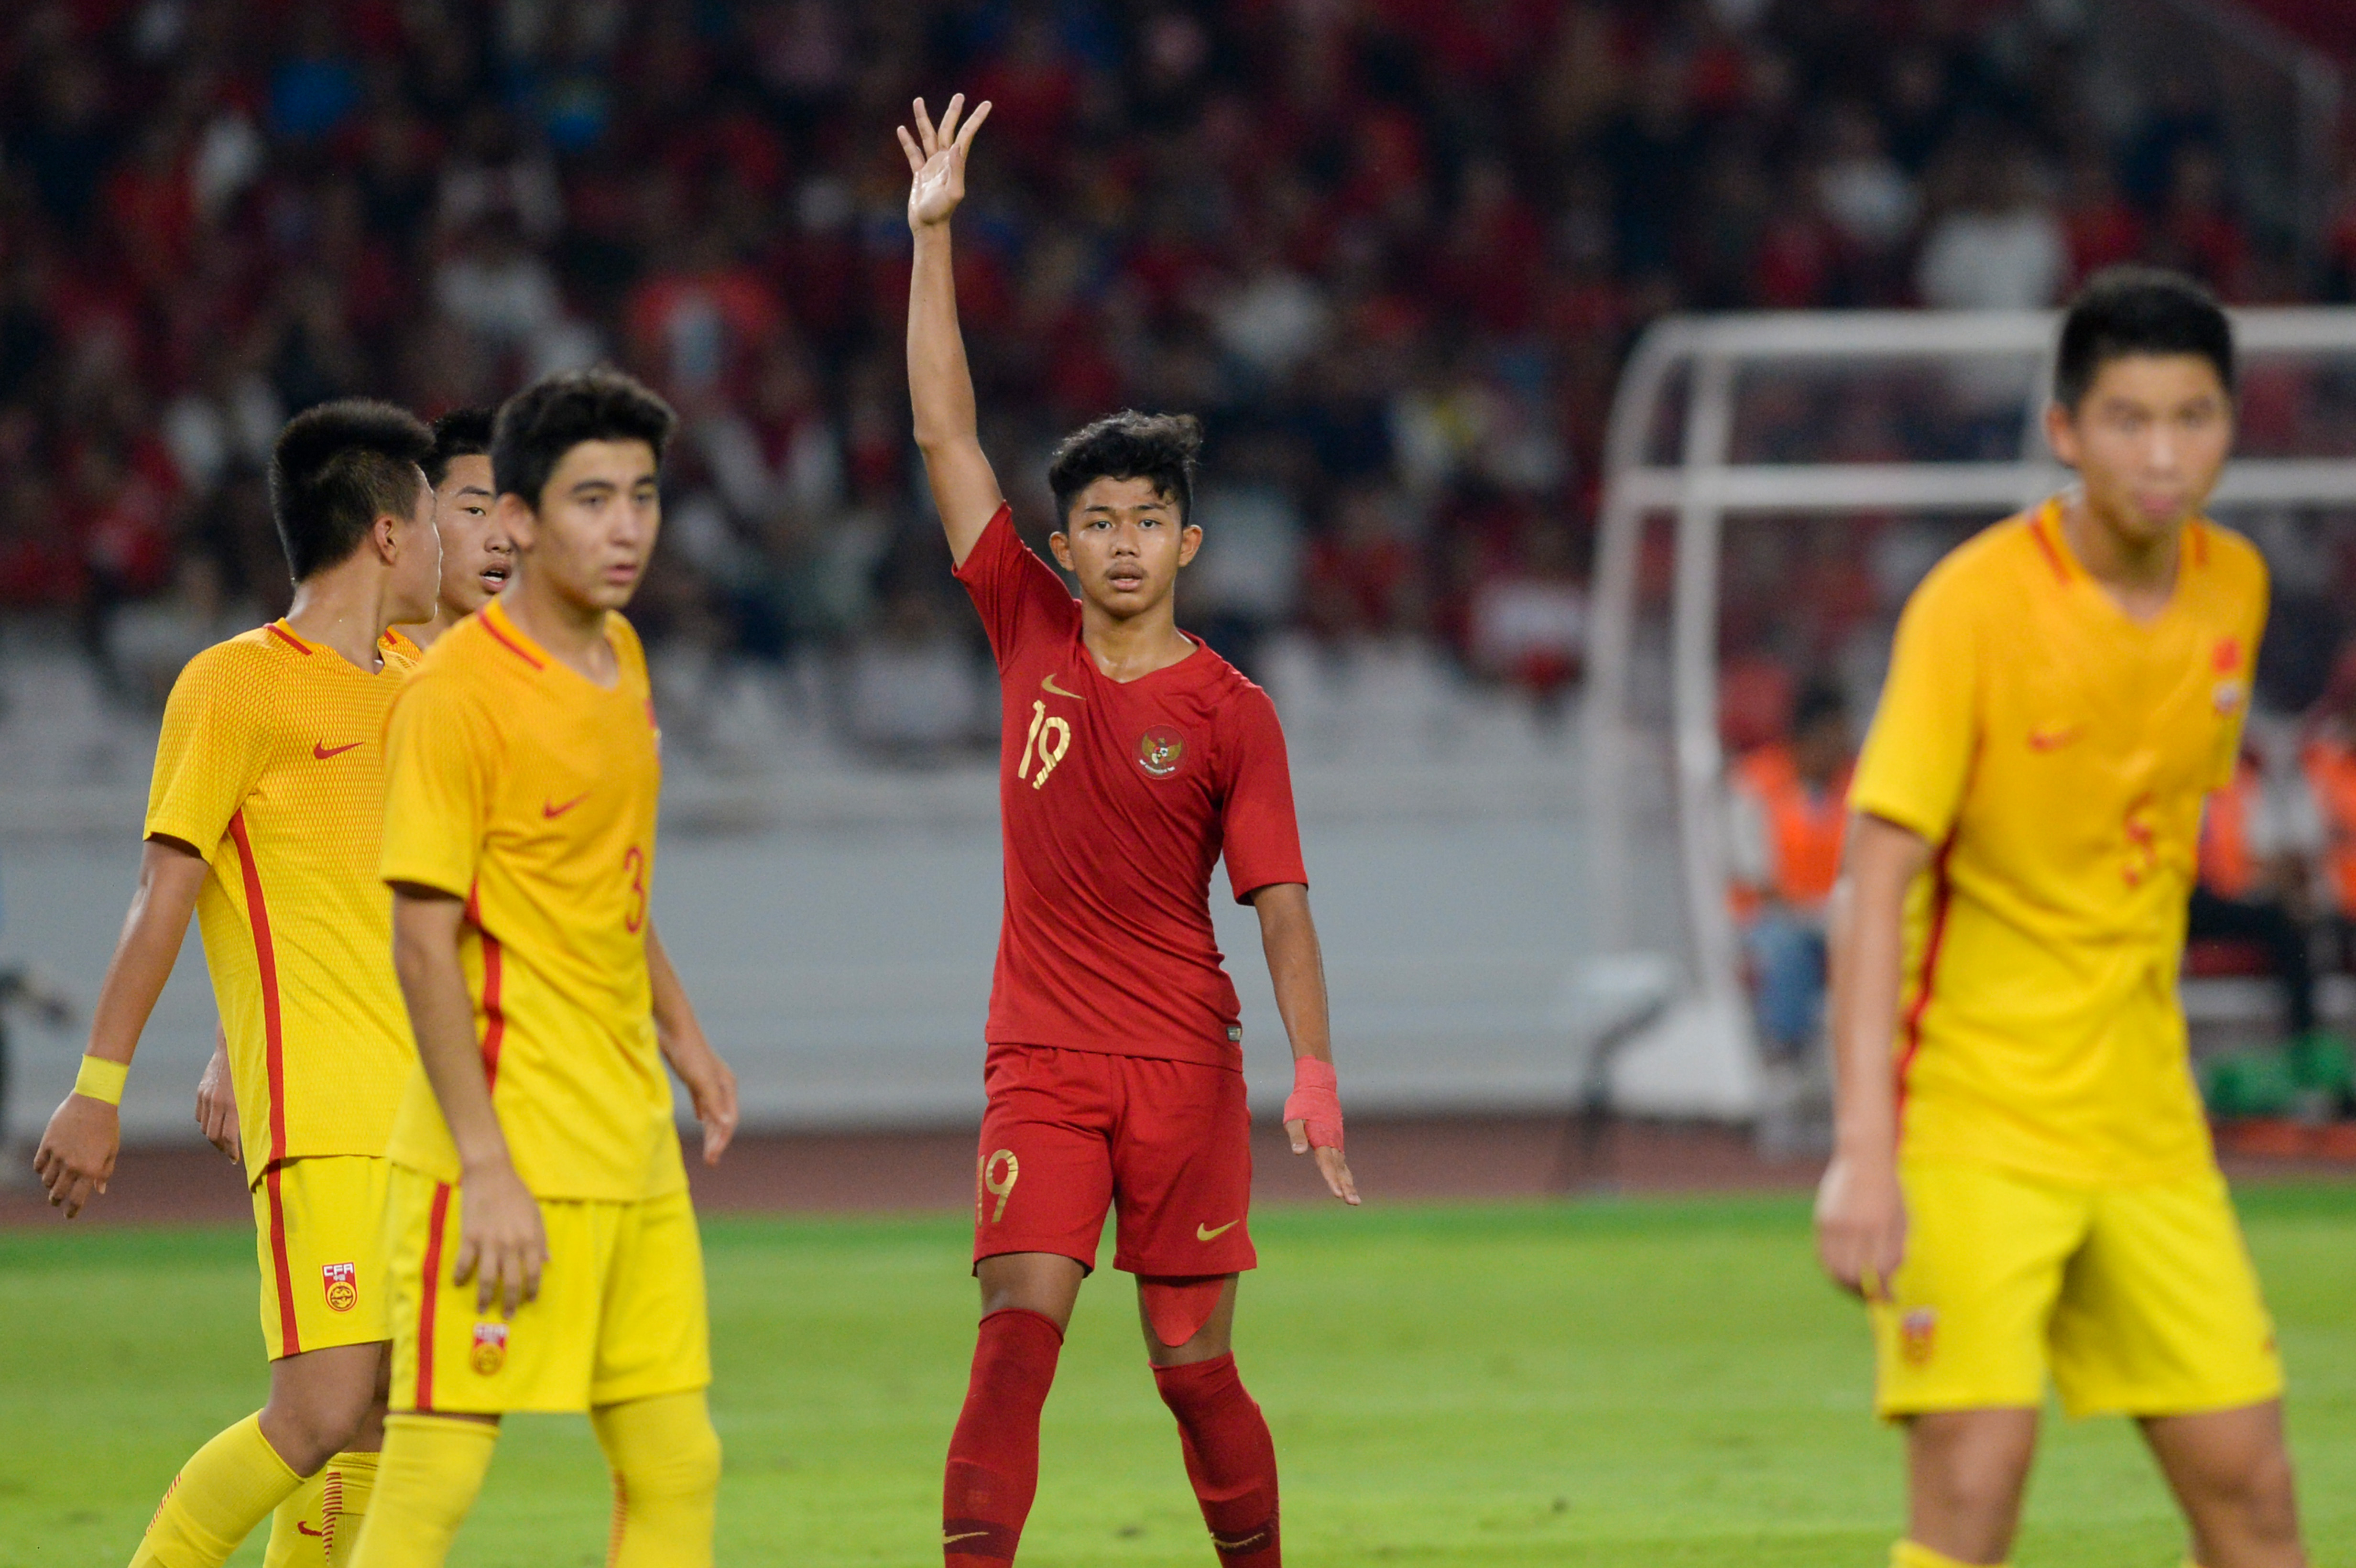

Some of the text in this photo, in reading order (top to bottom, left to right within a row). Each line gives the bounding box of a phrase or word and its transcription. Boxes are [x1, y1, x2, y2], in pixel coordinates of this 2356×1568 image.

[1018, 699, 1071, 790] 19
[624, 846, 644, 935] 3
[978, 1149, 1019, 1228] 19
[324, 1263, 353, 1276] CFA
